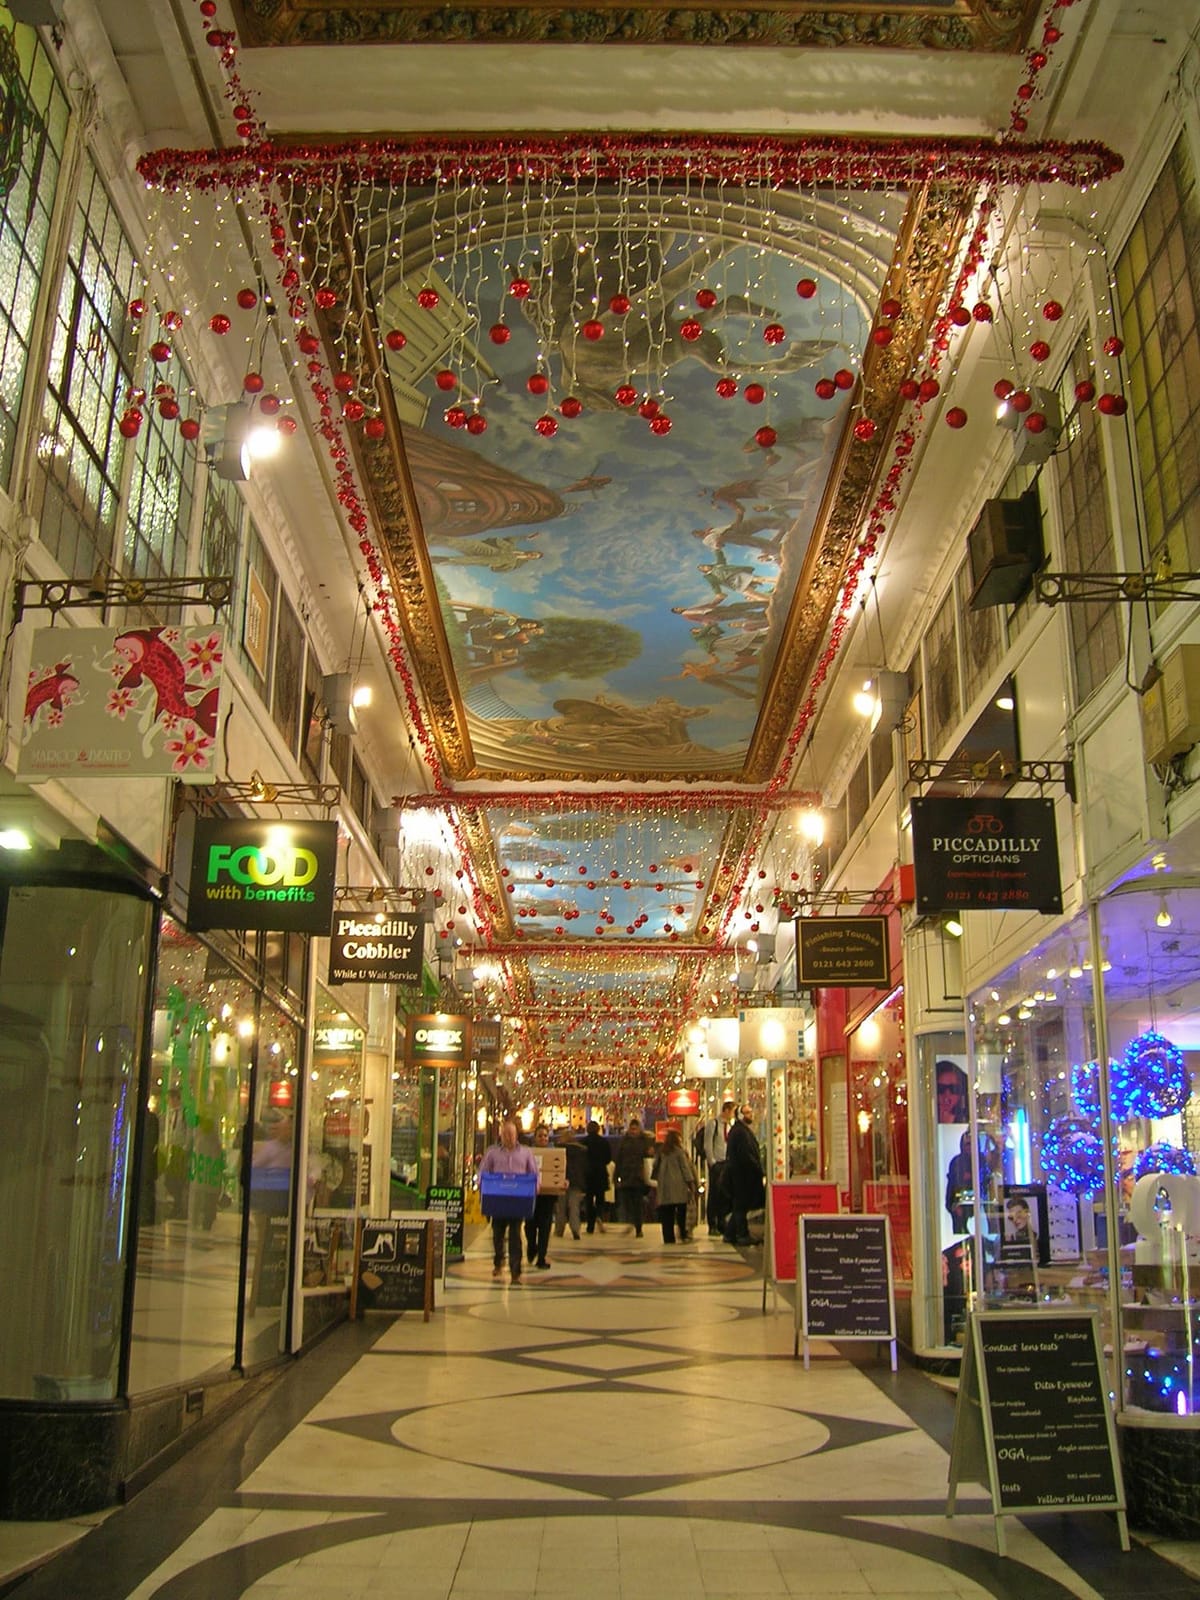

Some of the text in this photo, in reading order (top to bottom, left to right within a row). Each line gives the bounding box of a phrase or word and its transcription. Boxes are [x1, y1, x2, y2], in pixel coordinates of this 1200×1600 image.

[932, 838, 1041, 852] PICCADILLY
[952, 854, 1021, 864] OPTICIANS
[207, 845, 319, 887] FOOD
[206, 886, 316, 902] with benefits
[337, 920, 418, 940] Piccadilly
[805, 930, 843, 948] Finishing
[342, 942, 411, 959] Cobbler
[812, 960, 833, 968] 0121
[333, 969, 418, 980] While U Wait Service
[430, 1188, 461, 1200] onyx
[983, 1342, 1058, 1352] Contact lens tests
[1034, 1380, 1094, 1392] Dita Eyewear
[998, 1447, 1026, 1460] OGA
[1001, 1483, 1021, 1493] tests
[1036, 1494, 1065, 1505] Yellow
[1066, 1494, 1085, 1504] Plus
